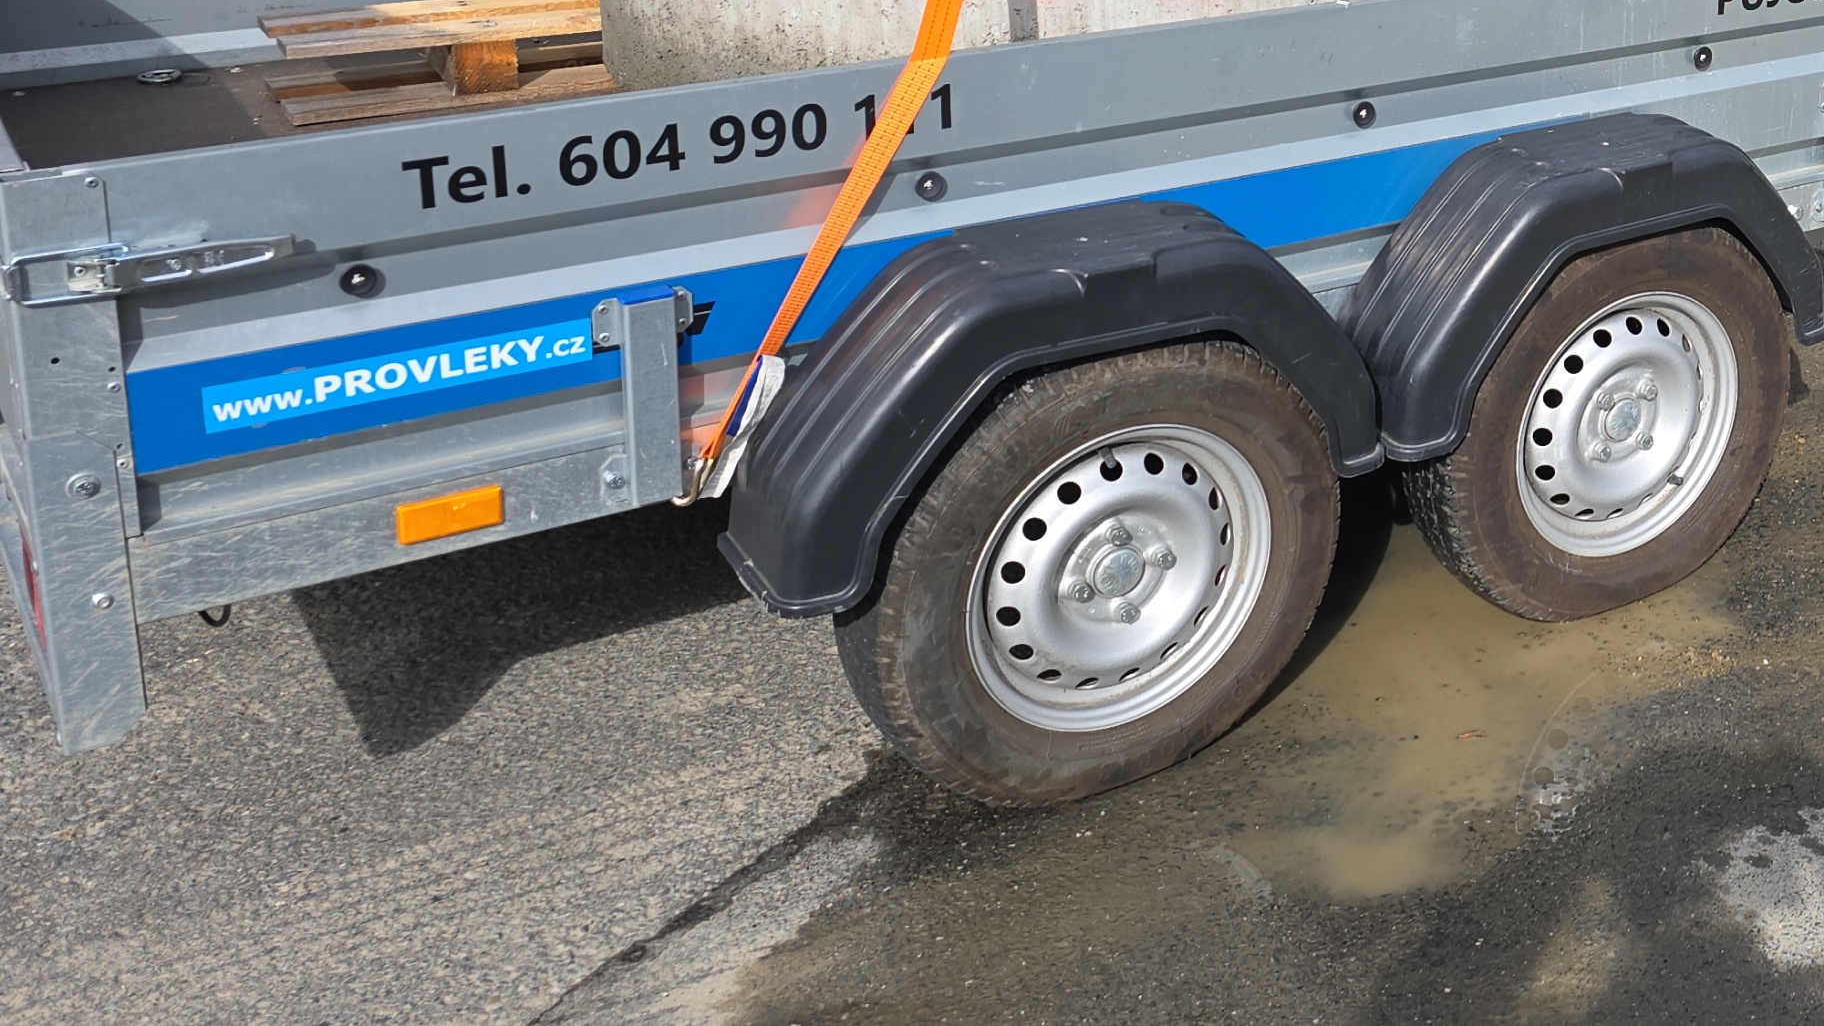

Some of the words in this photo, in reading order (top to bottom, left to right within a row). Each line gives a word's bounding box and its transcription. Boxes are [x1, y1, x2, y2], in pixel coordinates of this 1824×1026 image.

[401, 145, 532, 210] Tel.
[558, 122, 687, 188] 604
[709, 103, 828, 165] 990
[853, 83, 953, 142] 11
[211, 334, 587, 422] www.PROVLEKY.cz
